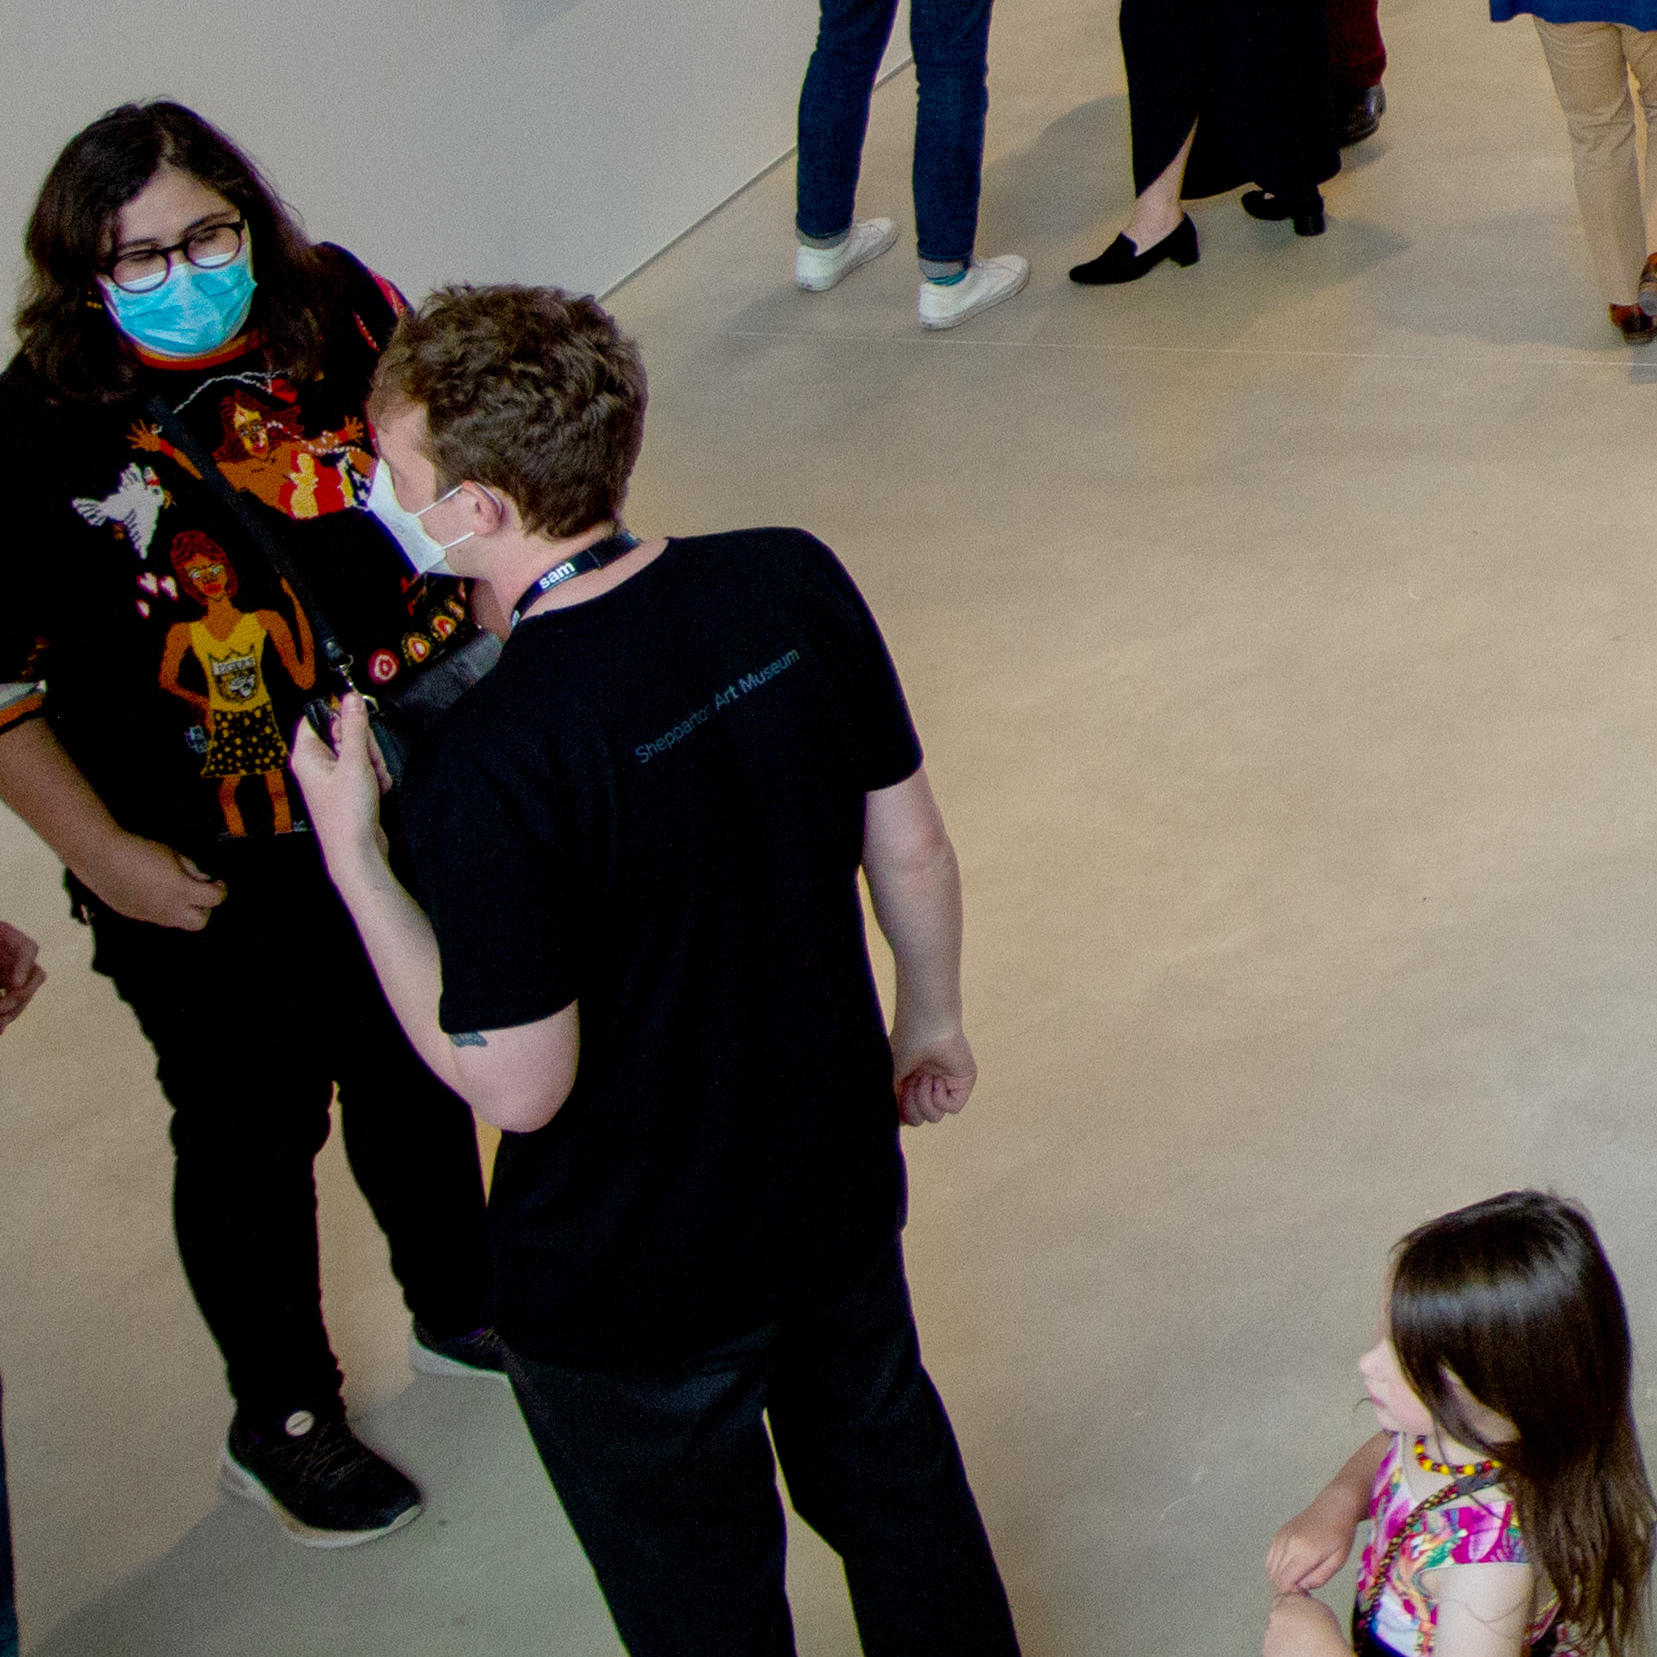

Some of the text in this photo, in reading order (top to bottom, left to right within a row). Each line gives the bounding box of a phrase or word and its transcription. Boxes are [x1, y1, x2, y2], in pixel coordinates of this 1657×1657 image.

[539, 562, 576, 590] sam
[713, 684, 740, 711] Art
[738, 649, 801, 694] Museum
